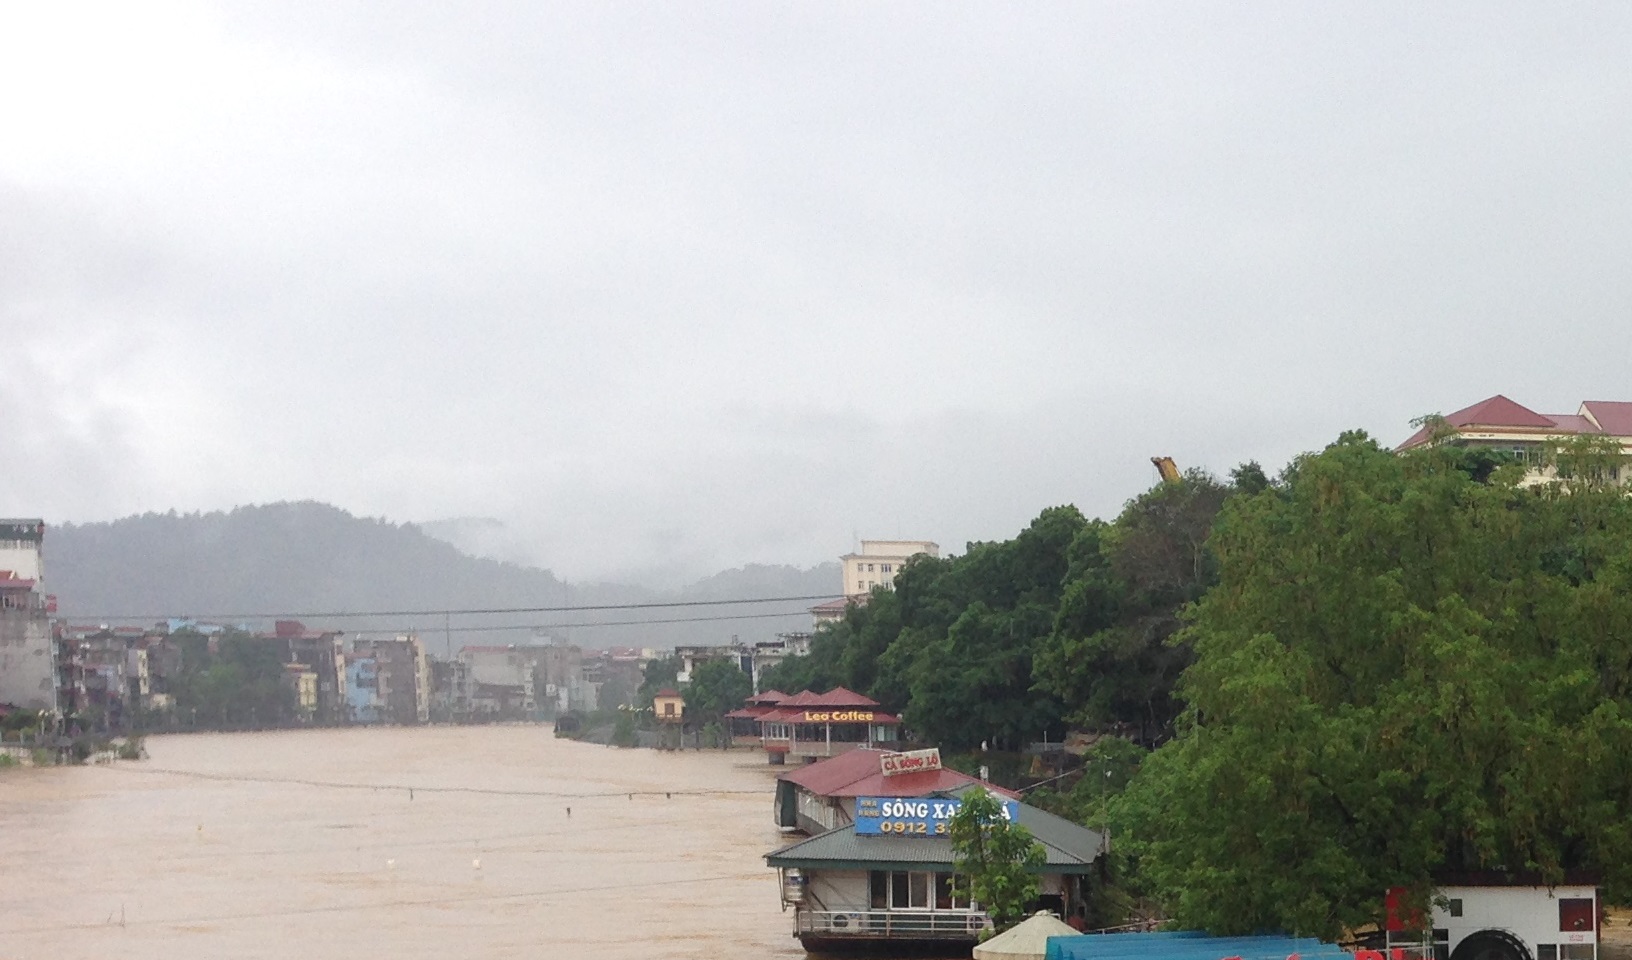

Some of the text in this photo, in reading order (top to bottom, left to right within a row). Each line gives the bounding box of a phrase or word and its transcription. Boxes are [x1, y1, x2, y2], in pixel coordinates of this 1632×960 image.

[832, 711, 873, 721] Coffee
[882, 798, 928, 819] SÔNG
[880, 821, 927, 834] 0912
